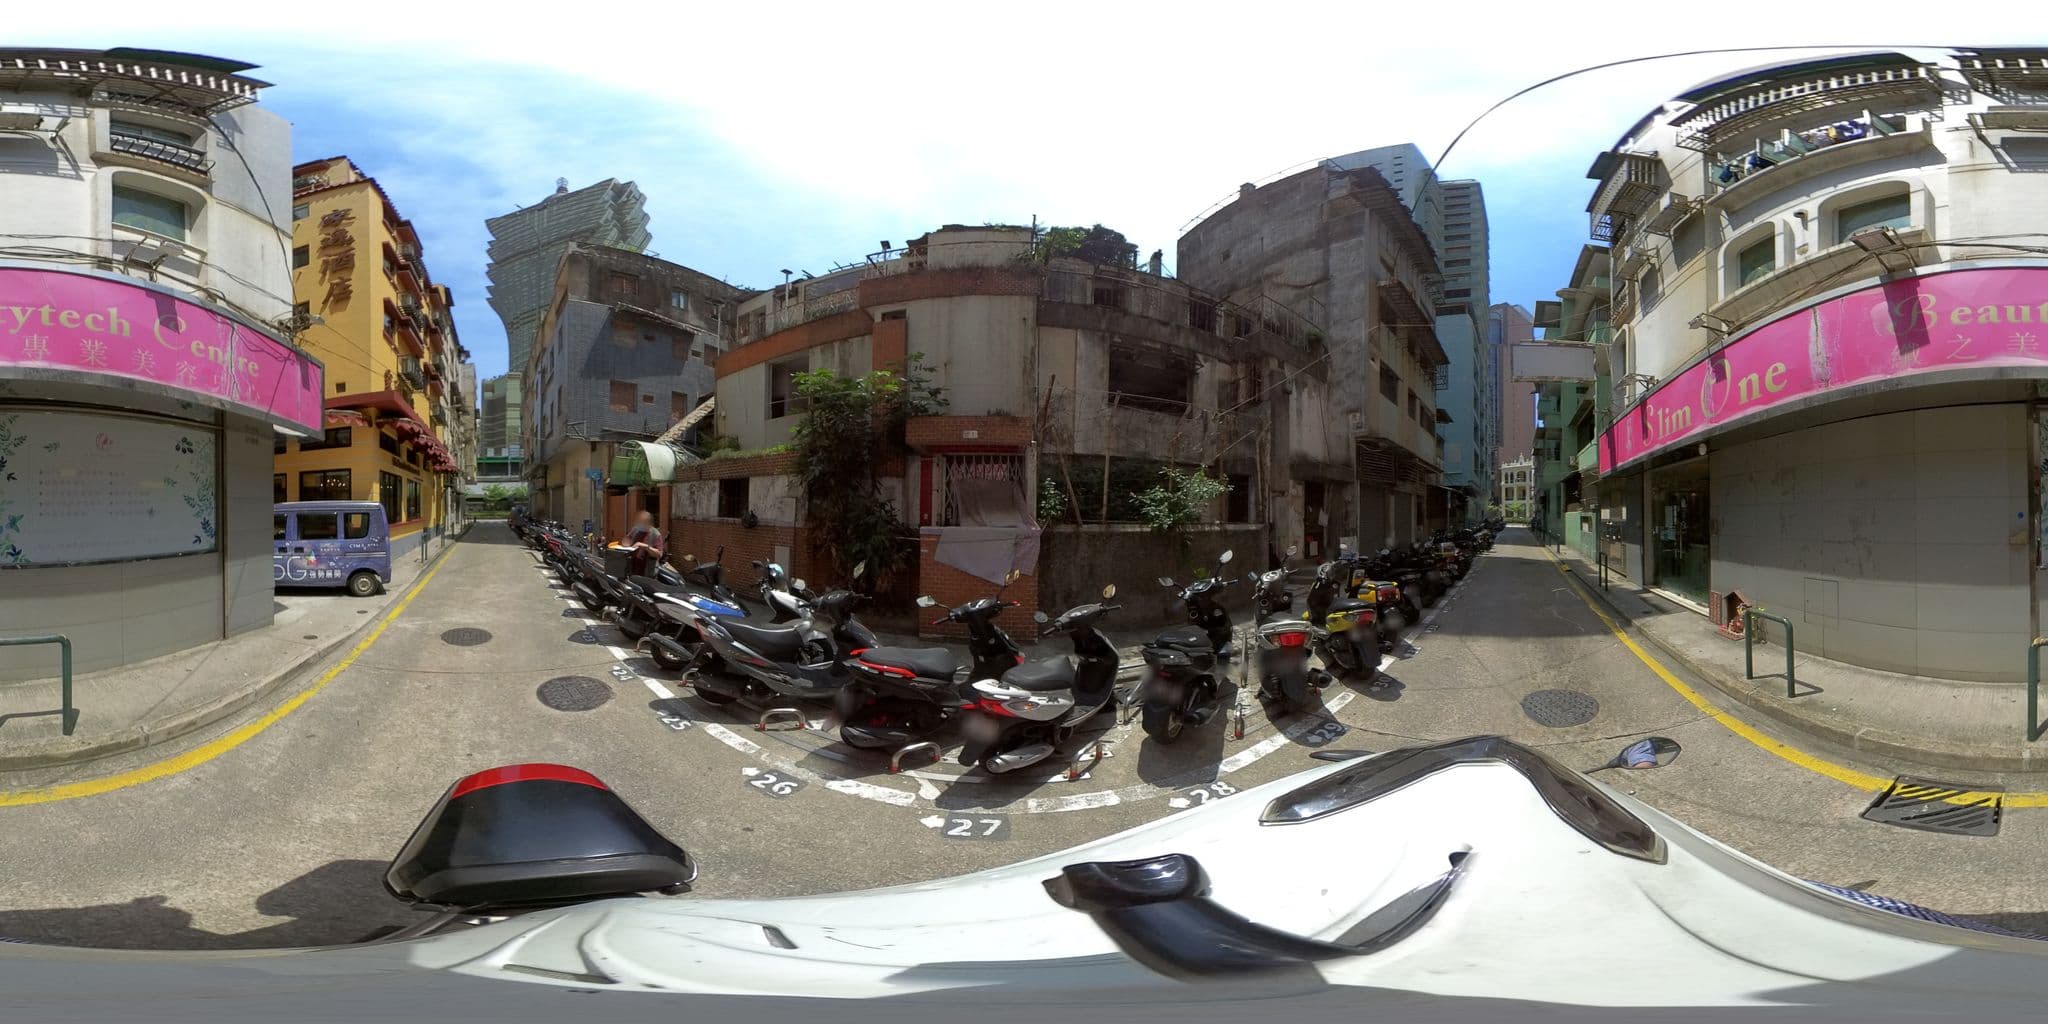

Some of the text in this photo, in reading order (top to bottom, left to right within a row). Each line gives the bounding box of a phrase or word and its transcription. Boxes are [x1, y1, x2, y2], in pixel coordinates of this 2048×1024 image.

[154, 314, 259, 377] Centre
[1643, 403, 1691, 447] Slim
[1700, 358, 1788, 418] One
[612, 668, 634, 681] 24
[1375, 675, 1393, 688] 30
[662, 717, 691, 731] 25
[1315, 722, 1342, 739] 29
[751, 774, 799, 795] 26
[1189, 780, 1237, 806] 28
[947, 818, 1003, 837] 27
